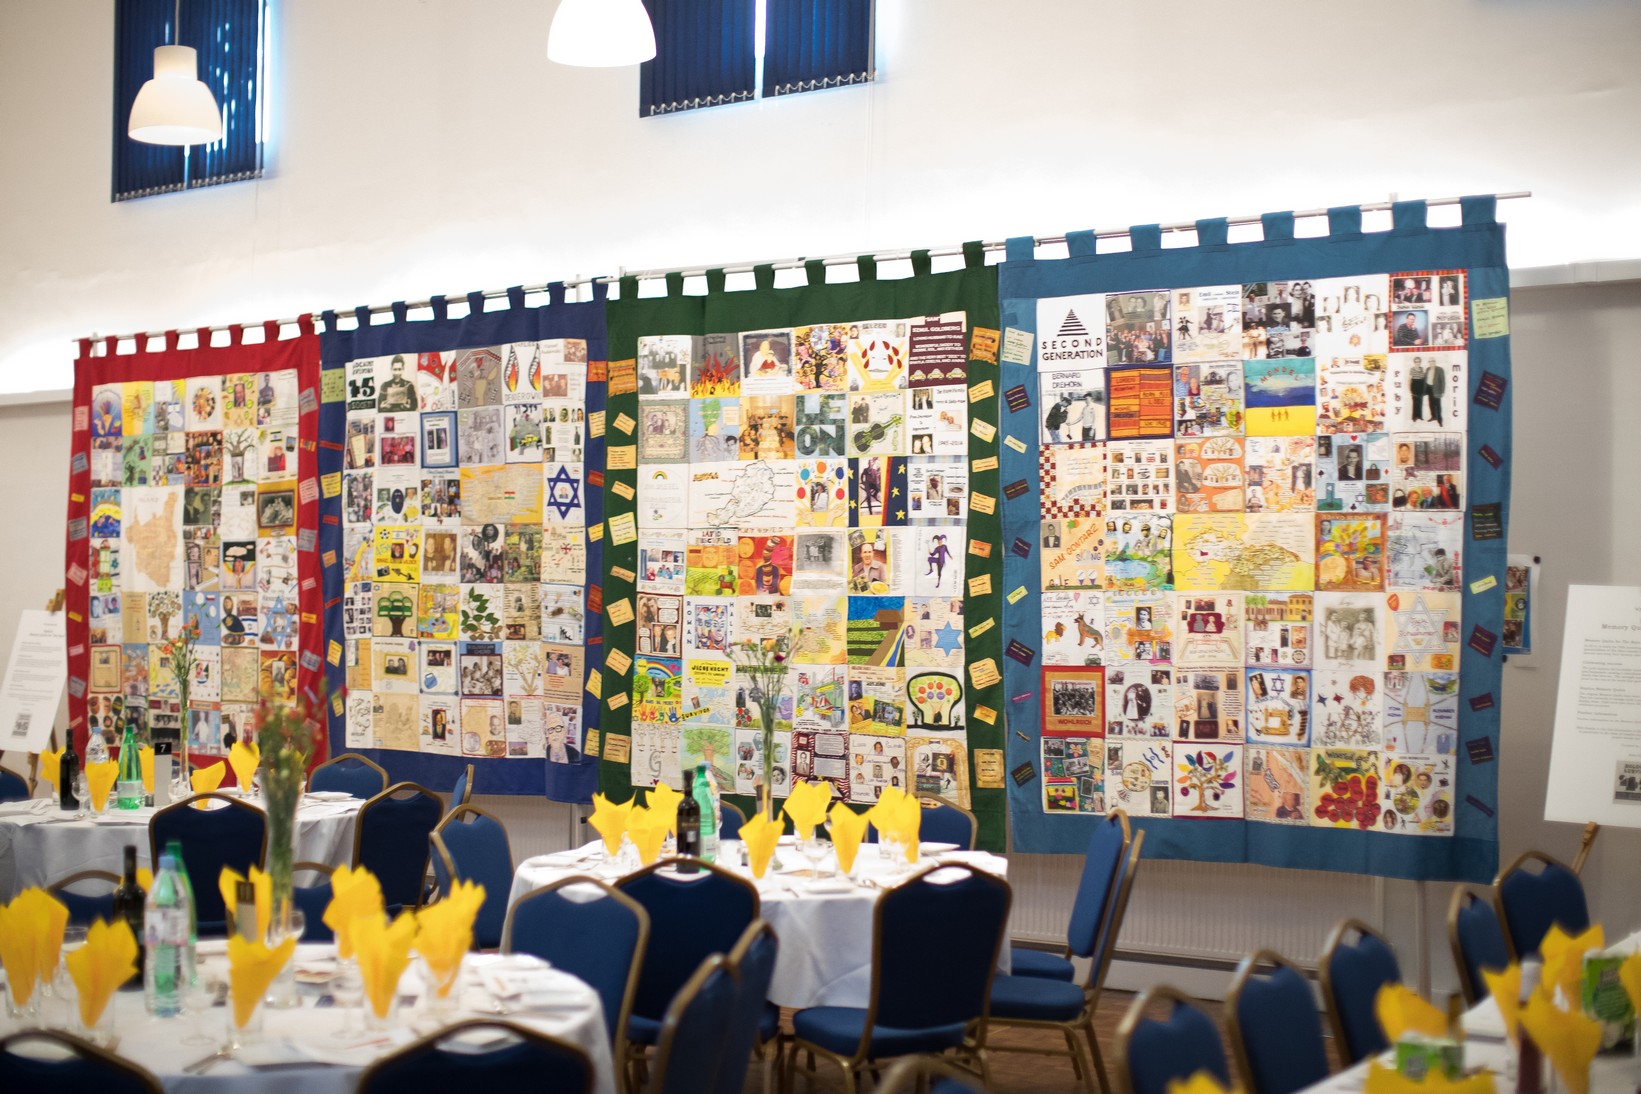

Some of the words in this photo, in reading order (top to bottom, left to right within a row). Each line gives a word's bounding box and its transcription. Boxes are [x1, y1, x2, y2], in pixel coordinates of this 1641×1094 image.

[1042, 337, 1103, 350] SECOND
[1042, 349, 1104, 361] GENERATION
[1260, 366, 1300, 383] MENDEL
[1048, 553, 1066, 570] SAM
[681, 707, 710, 719] SURVIVOR
[160, 744, 166, 753] 7
